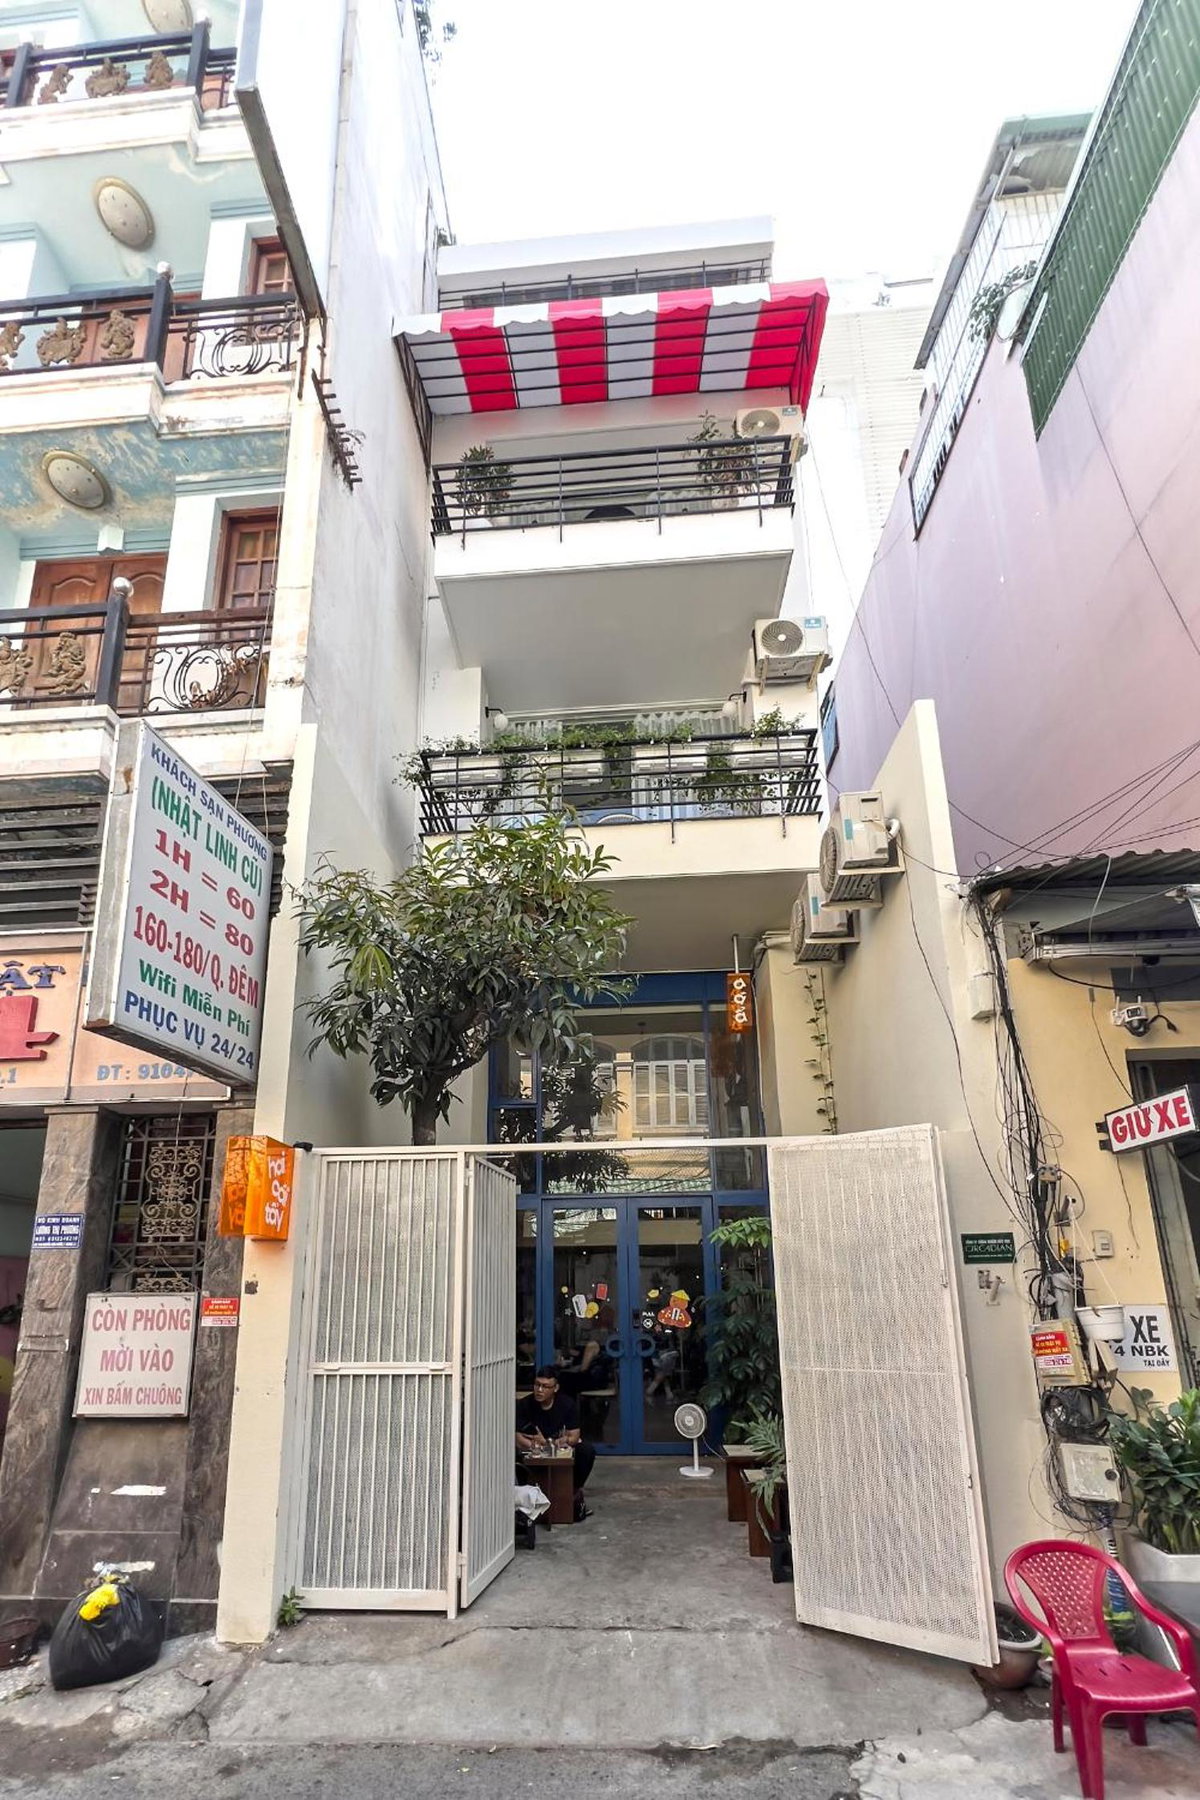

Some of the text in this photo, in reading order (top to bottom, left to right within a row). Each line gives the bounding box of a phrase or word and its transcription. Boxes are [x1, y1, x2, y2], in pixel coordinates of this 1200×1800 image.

[151, 743, 197, 796] KHÁCH
[200, 789, 224, 821] SẠN
[152, 776, 263, 897] (NHẬT LINH CŨ)
[155, 829, 256, 920] 1H = 60
[150, 869, 255, 956] 2H = 80
[139, 959, 250, 1037] Wifi Miễn Phí
[229, 965, 259, 1008] ĐÊM
[124, 990, 254, 1069] PHỤC VỤ 24/24
[1153, 1096, 1191, 1133] XE
[92, 1302, 191, 1332] CÒN PHÒNG
[1130, 1315, 1161, 1343] XE
[100, 1343, 174, 1372] MỜI VÀO
[1131, 1345, 1169, 1356] NBK
[84, 1381, 182, 1405] XIN BẤM CHUÔNG
